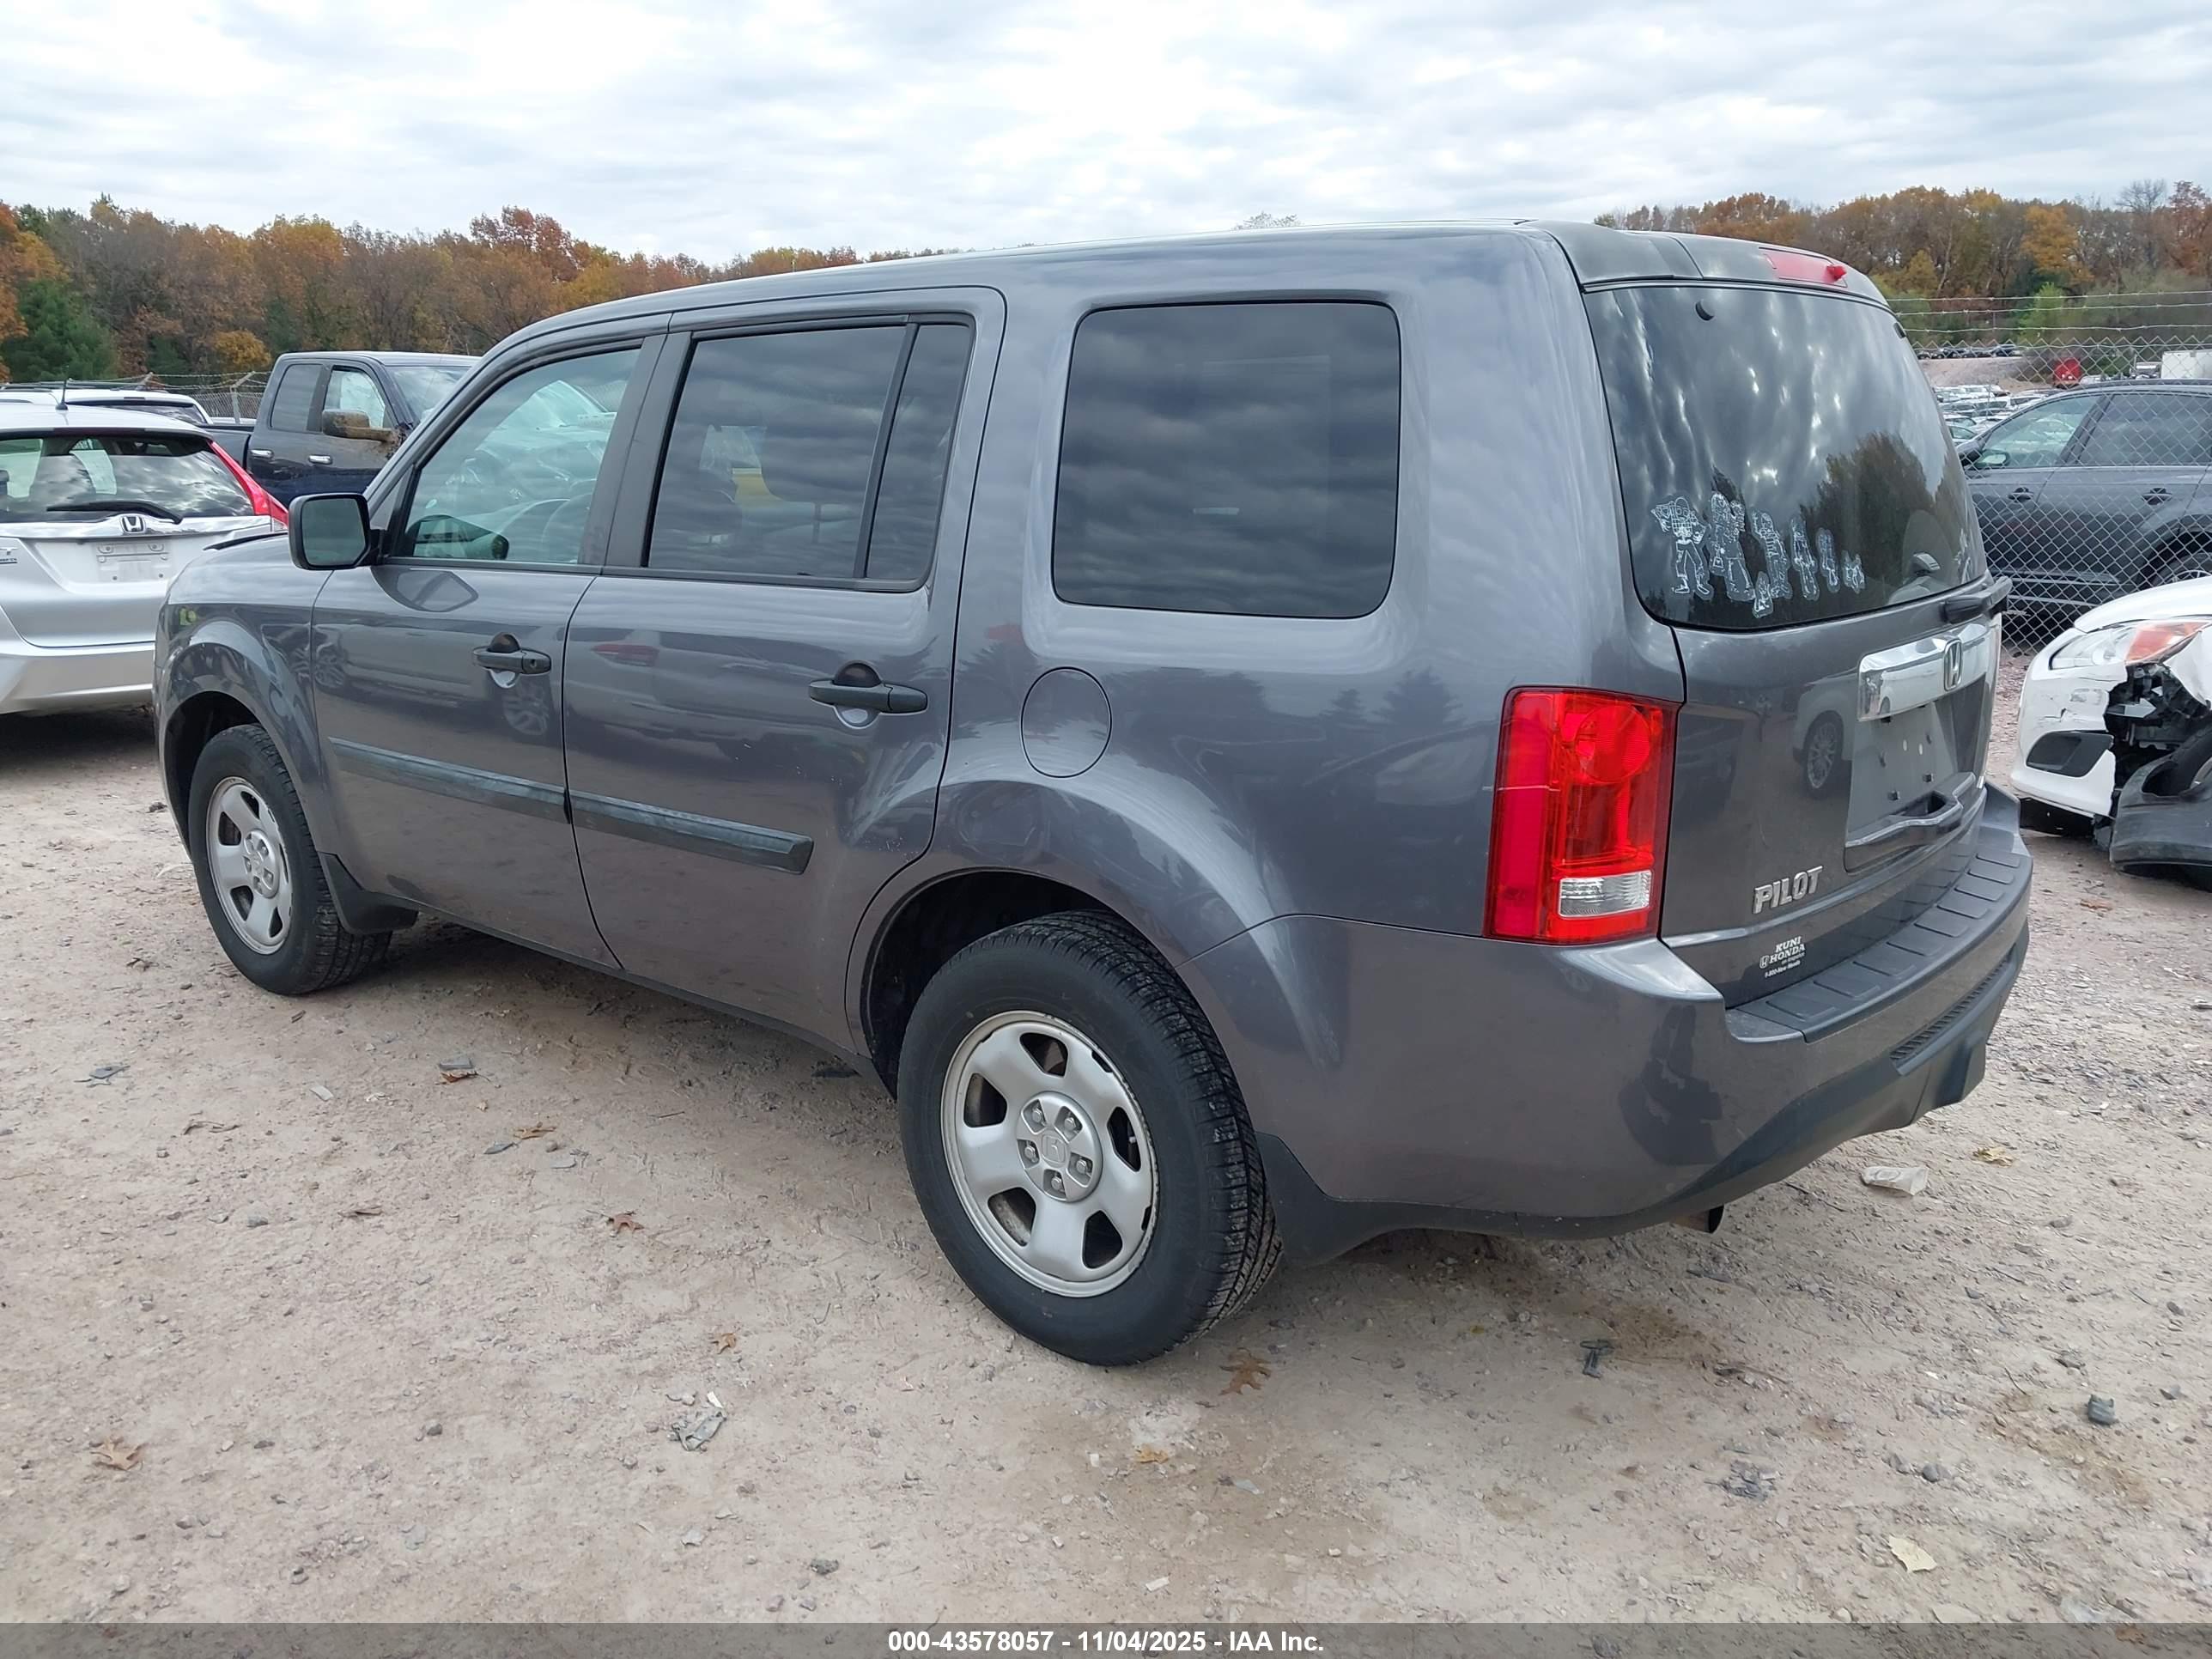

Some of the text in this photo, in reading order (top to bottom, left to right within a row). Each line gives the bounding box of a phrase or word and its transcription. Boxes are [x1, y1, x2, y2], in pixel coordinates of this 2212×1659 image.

[1753, 866, 1823, 914] PILOT
[1769, 944, 1805, 963] HONDA
[1776, 936, 1802, 952] KUNI
